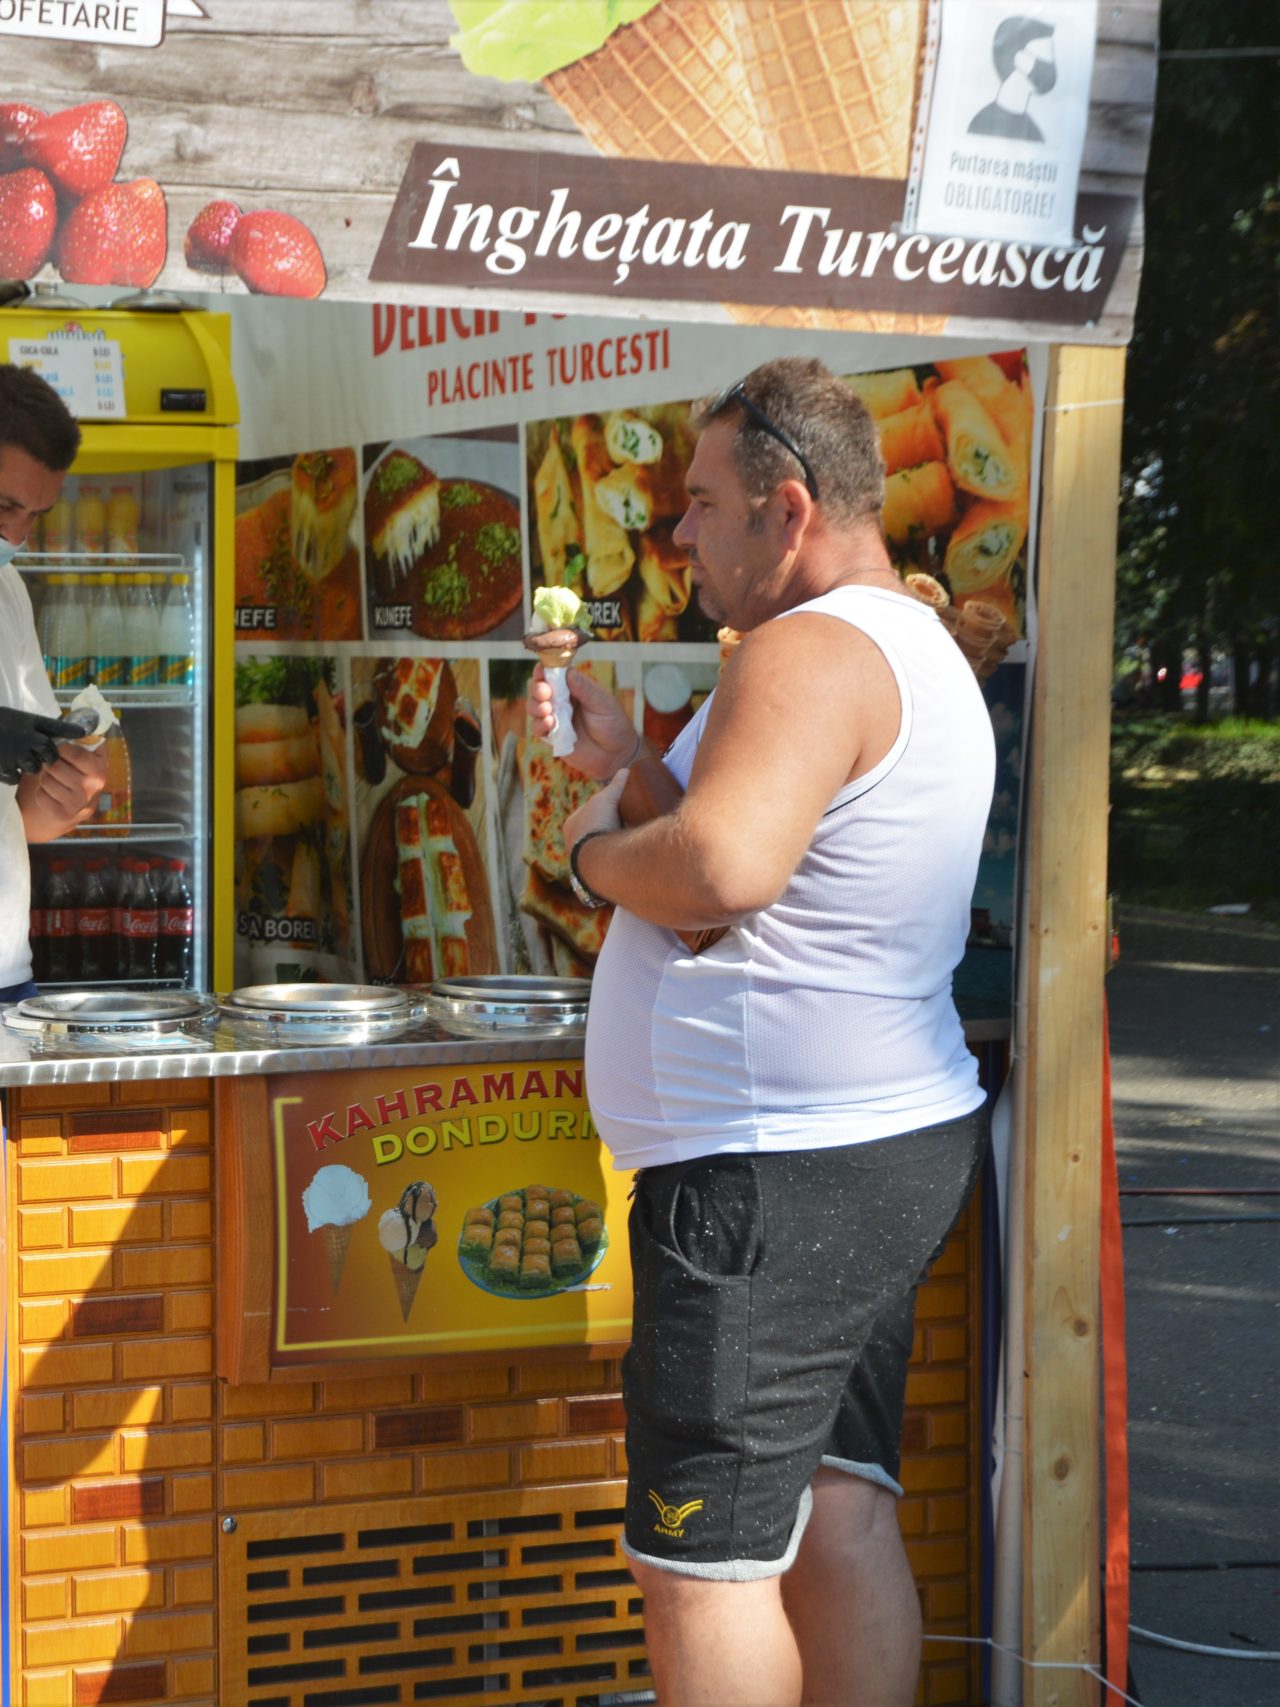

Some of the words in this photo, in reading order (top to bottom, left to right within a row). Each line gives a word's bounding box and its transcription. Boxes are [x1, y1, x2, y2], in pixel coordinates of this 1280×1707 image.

[949, 150, 1010, 177] Purtarea
[408, 157, 747, 286] Înghețata
[772, 204, 1107, 293] Turcească
[943, 181, 1056, 219] OBLIGATORIE!
[427, 352, 534, 407] PLACINTE
[546, 327, 670, 387] TURCESTI
[264, 919, 313, 939] BORE
[306, 1068, 585, 1152] KAHRAMAN
